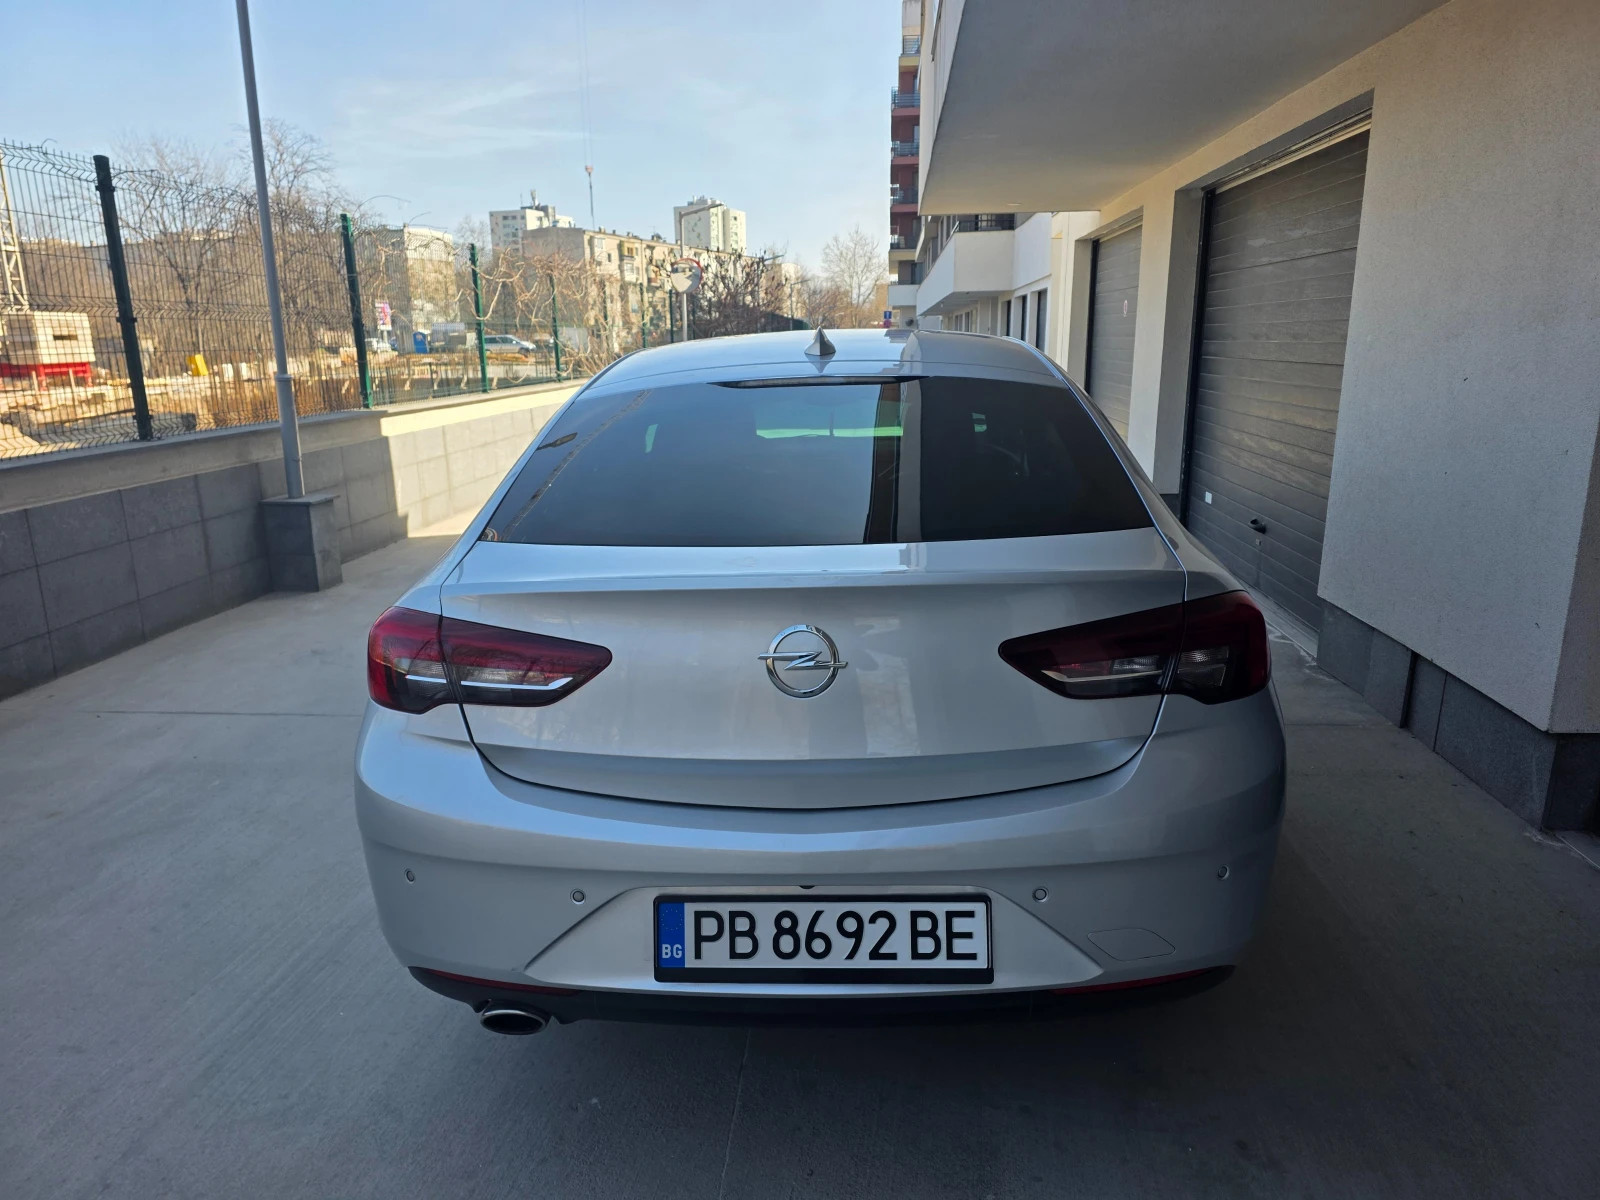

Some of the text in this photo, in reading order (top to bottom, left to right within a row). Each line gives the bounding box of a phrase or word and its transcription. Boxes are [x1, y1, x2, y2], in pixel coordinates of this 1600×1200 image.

[661, 943, 683, 959] BG
[694, 910, 978, 960] PB 8692 BE
